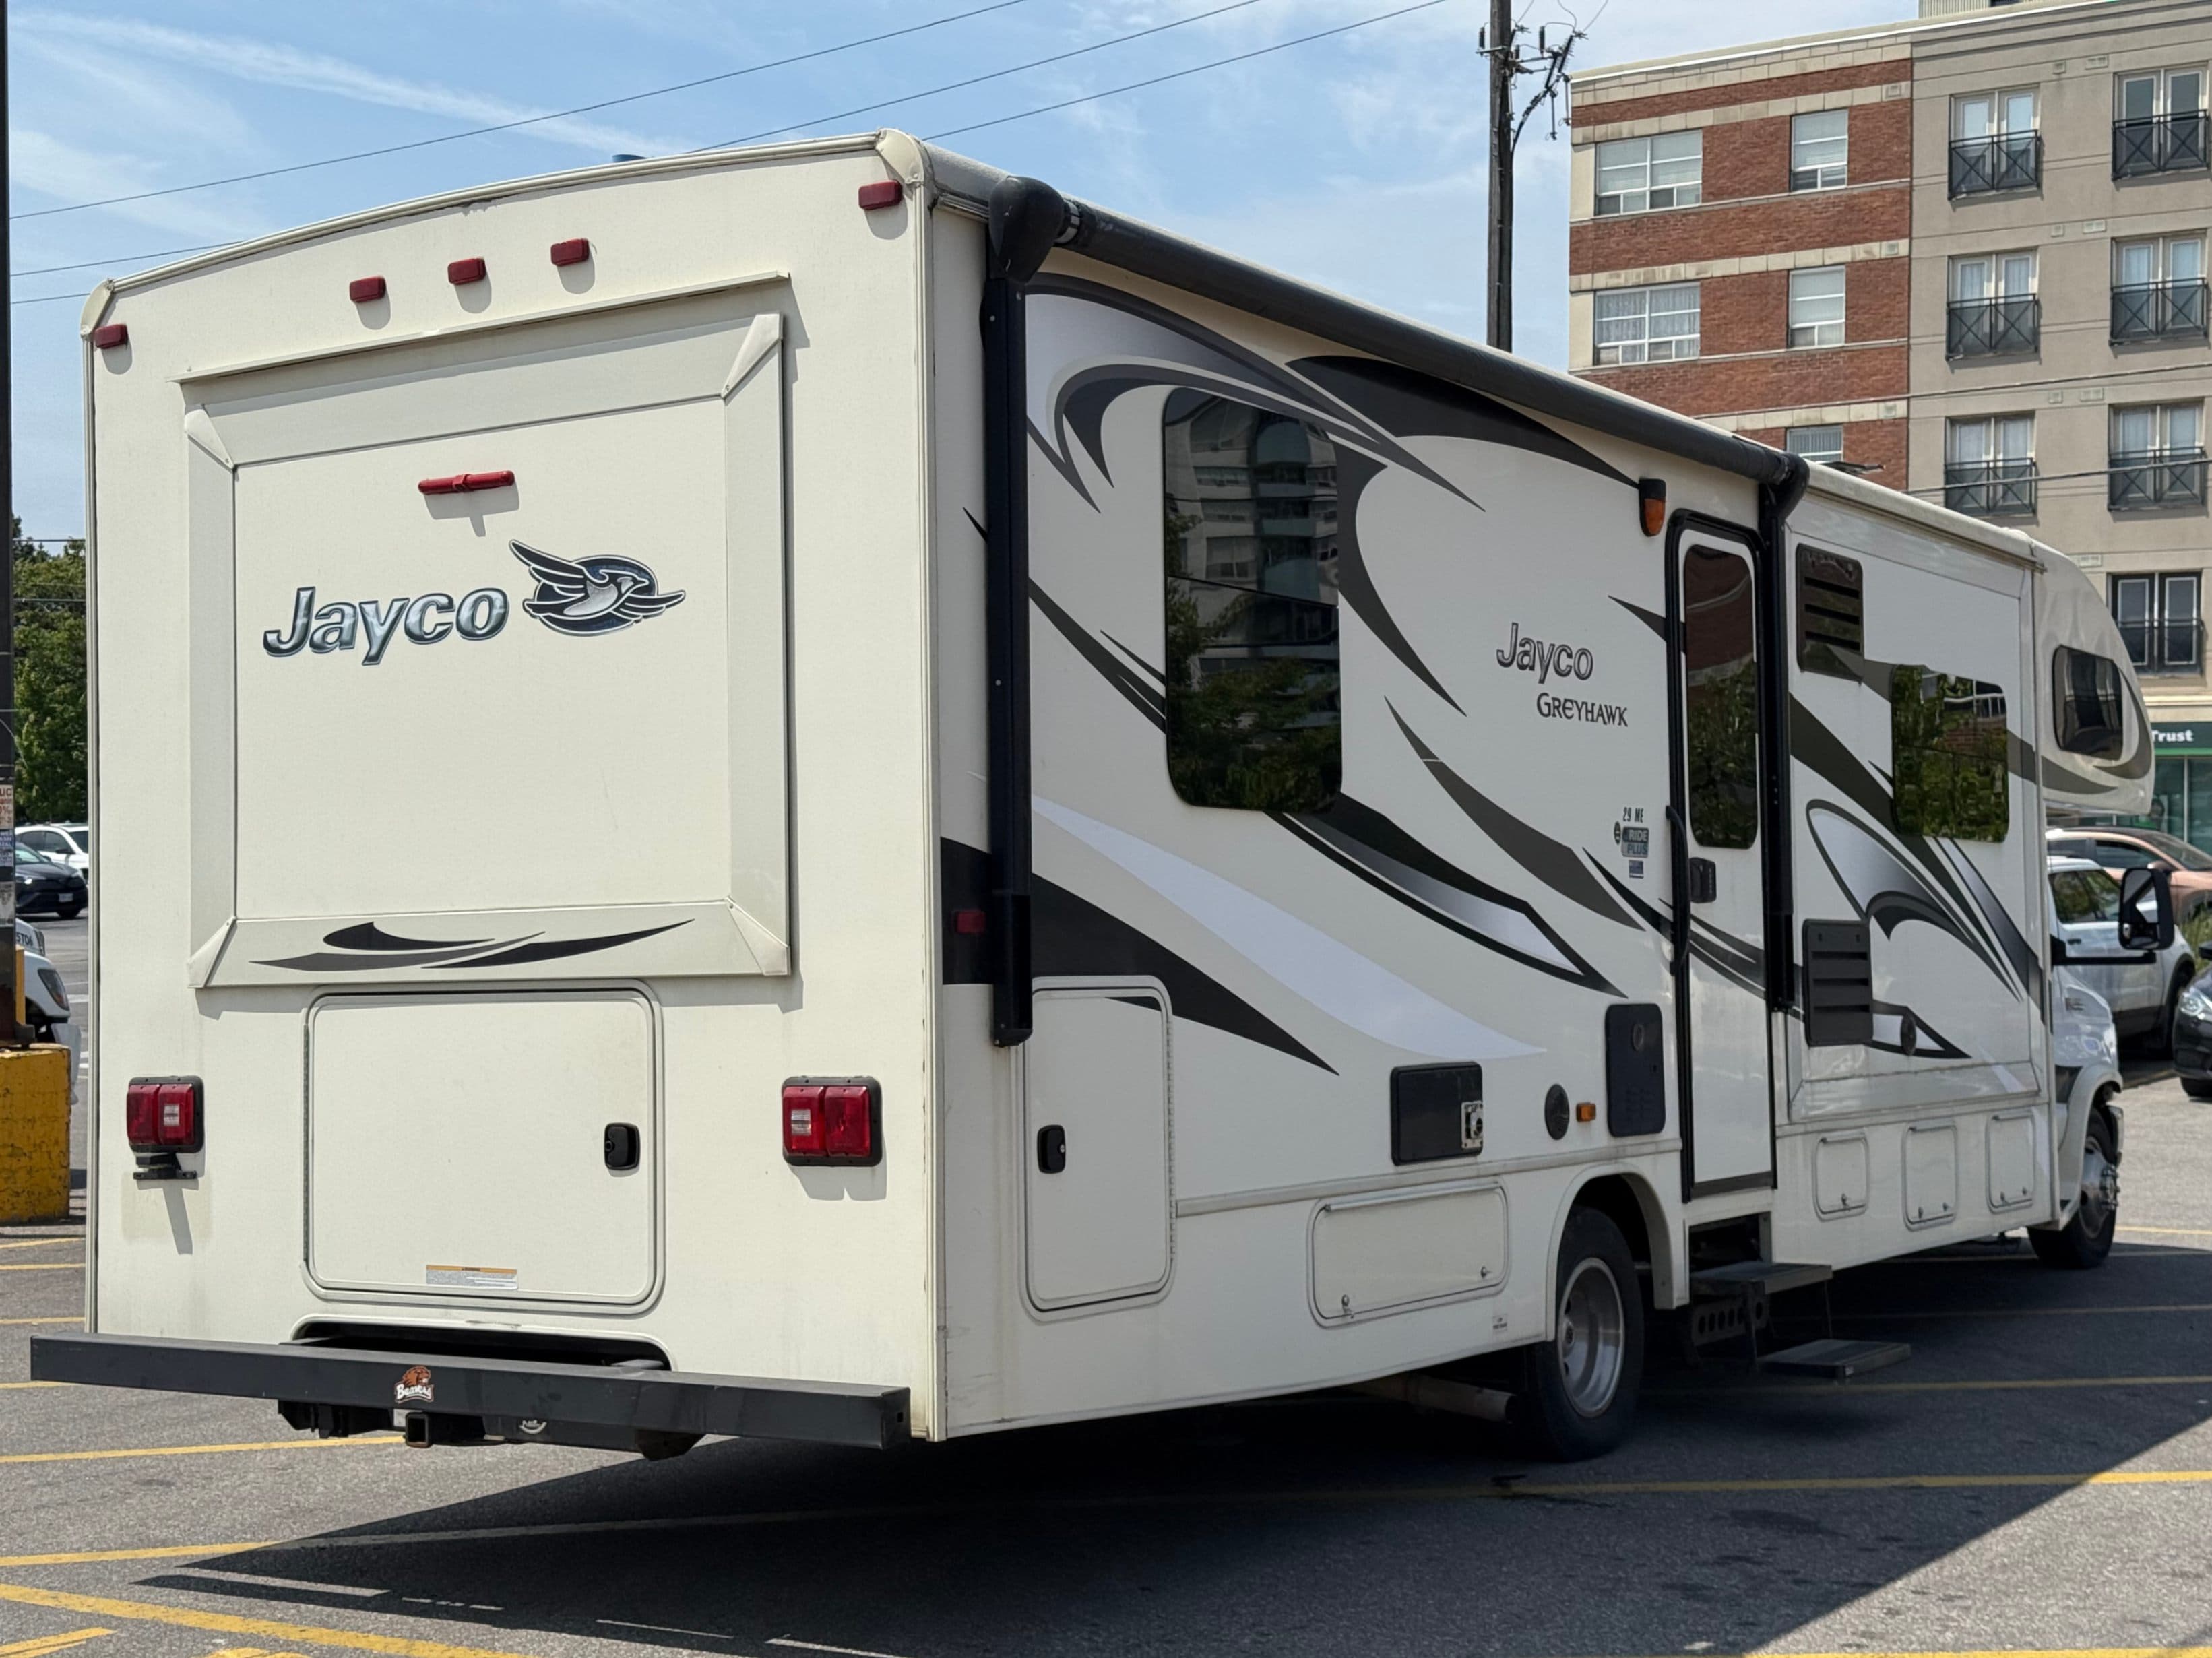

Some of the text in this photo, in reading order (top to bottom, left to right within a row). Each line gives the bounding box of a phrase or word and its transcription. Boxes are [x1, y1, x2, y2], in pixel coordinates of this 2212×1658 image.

[263, 586, 509, 666] Jayco
[1496, 622, 1594, 684] Jayco
[2152, 729, 2194, 742] Trust
